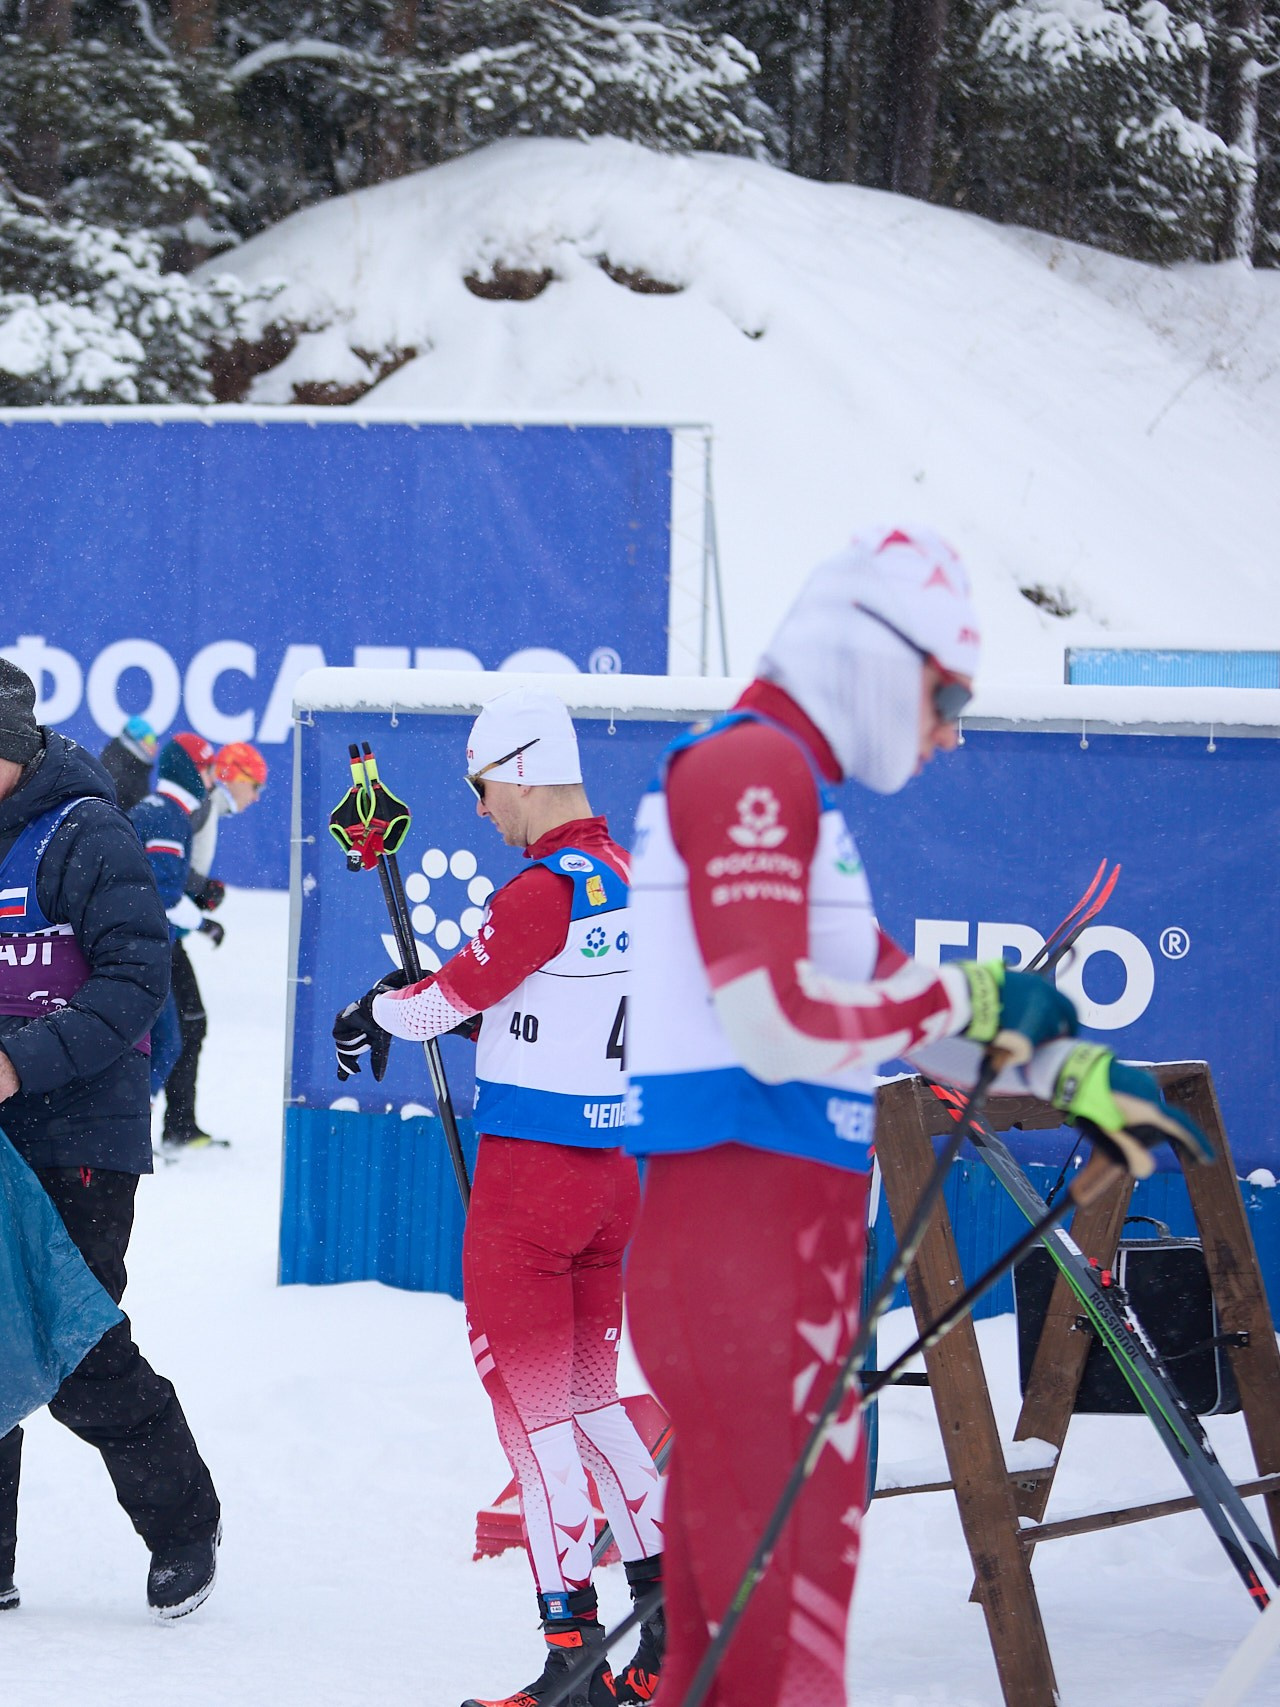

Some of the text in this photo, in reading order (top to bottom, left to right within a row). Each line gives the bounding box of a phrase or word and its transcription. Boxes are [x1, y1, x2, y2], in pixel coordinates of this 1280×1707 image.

[510, 1011, 538, 1043] 40
[606, 995, 628, 1072] 4
[583, 1102, 627, 1128] ЧЕПЕ
[1089, 1291, 1140, 1365] ROSSIGNOL
